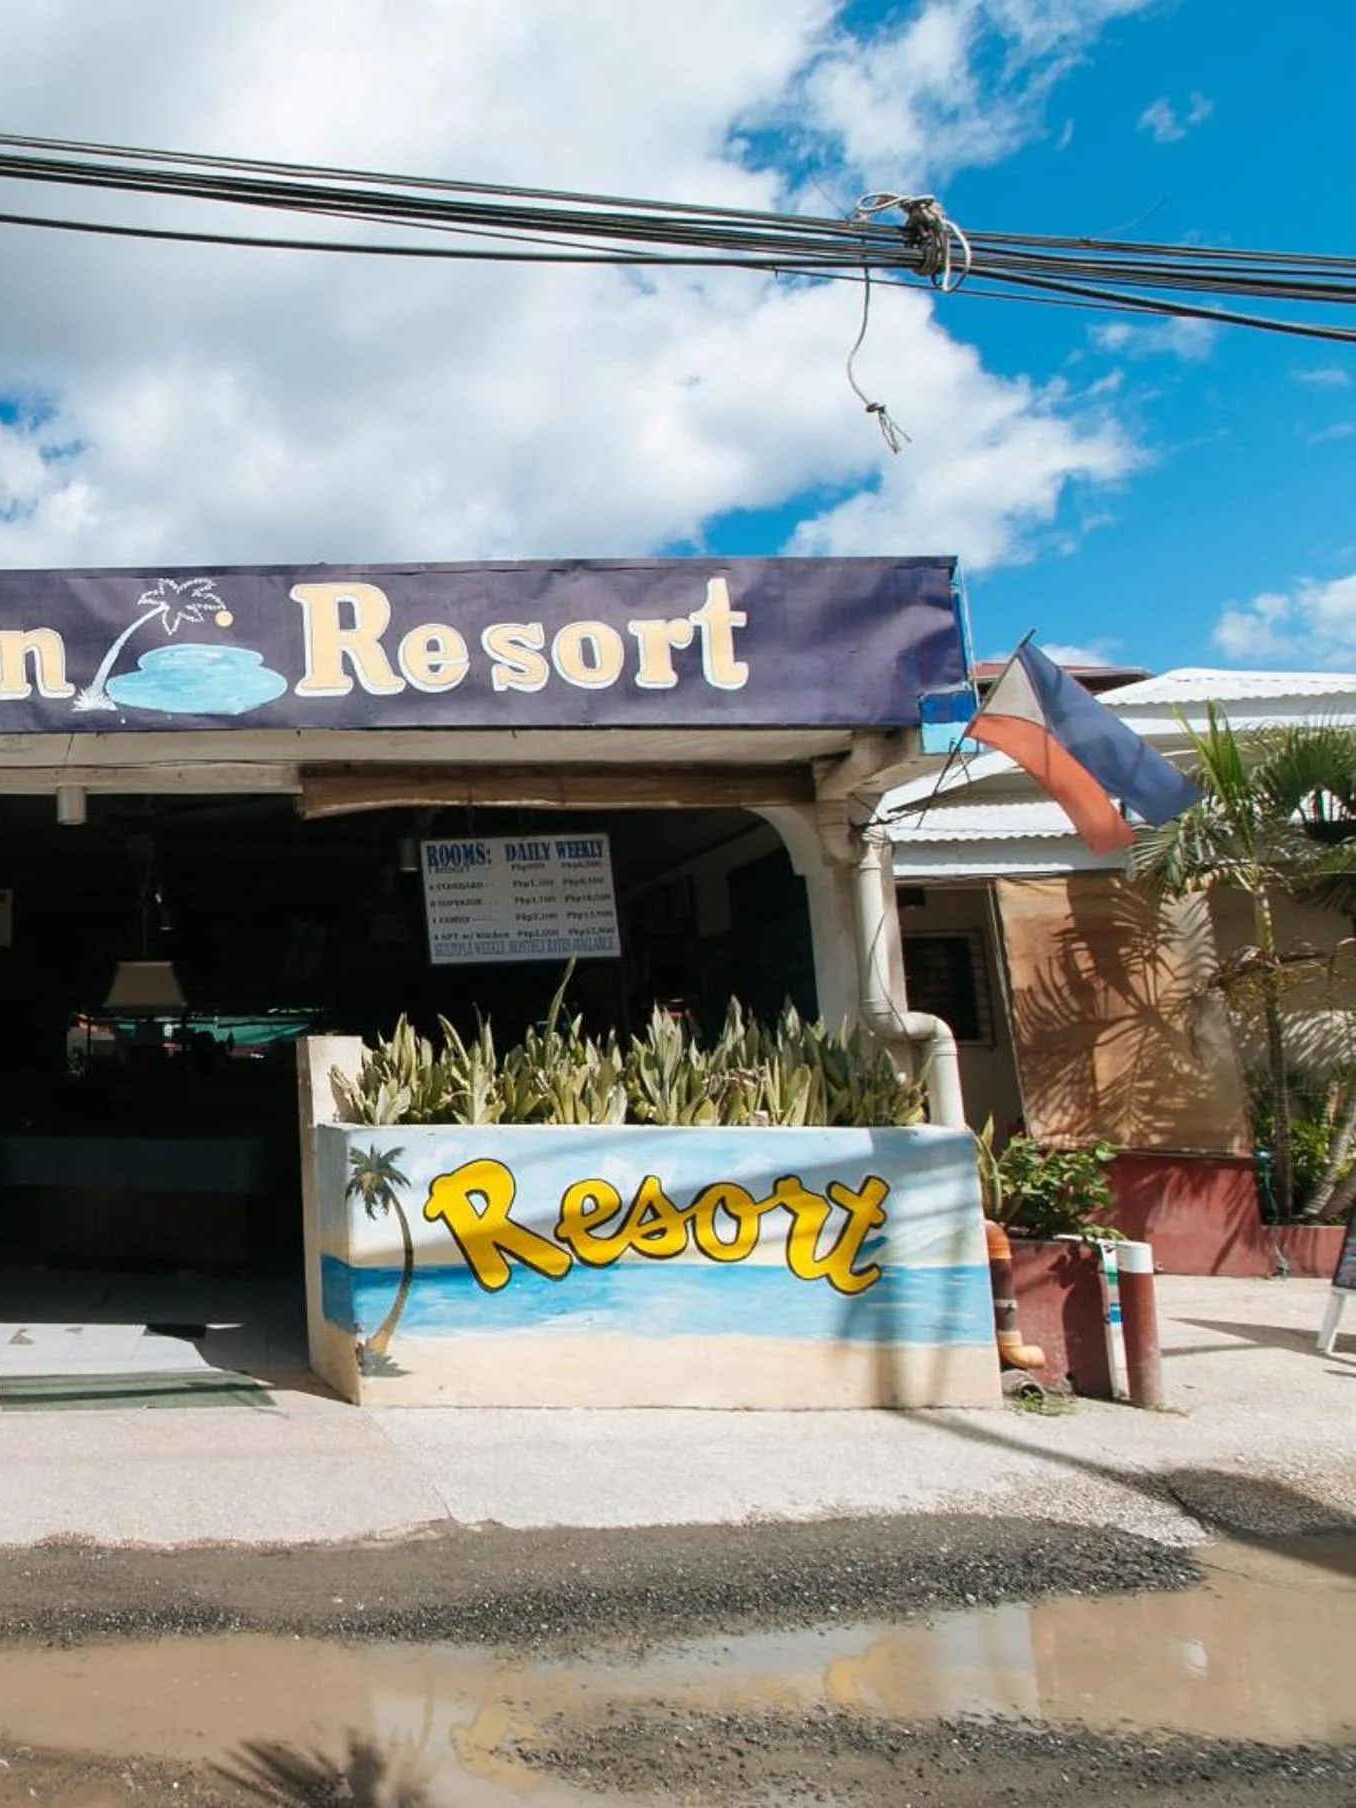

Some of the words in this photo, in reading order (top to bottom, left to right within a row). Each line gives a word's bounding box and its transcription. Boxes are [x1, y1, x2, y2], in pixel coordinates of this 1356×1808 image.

[289, 576, 750, 698] Resort
[426, 842, 493, 867] ROOMS:
[504, 842, 551, 861] DAILY
[556, 839, 604, 859] WEEKLY
[422, 1156, 890, 1297] Resort
